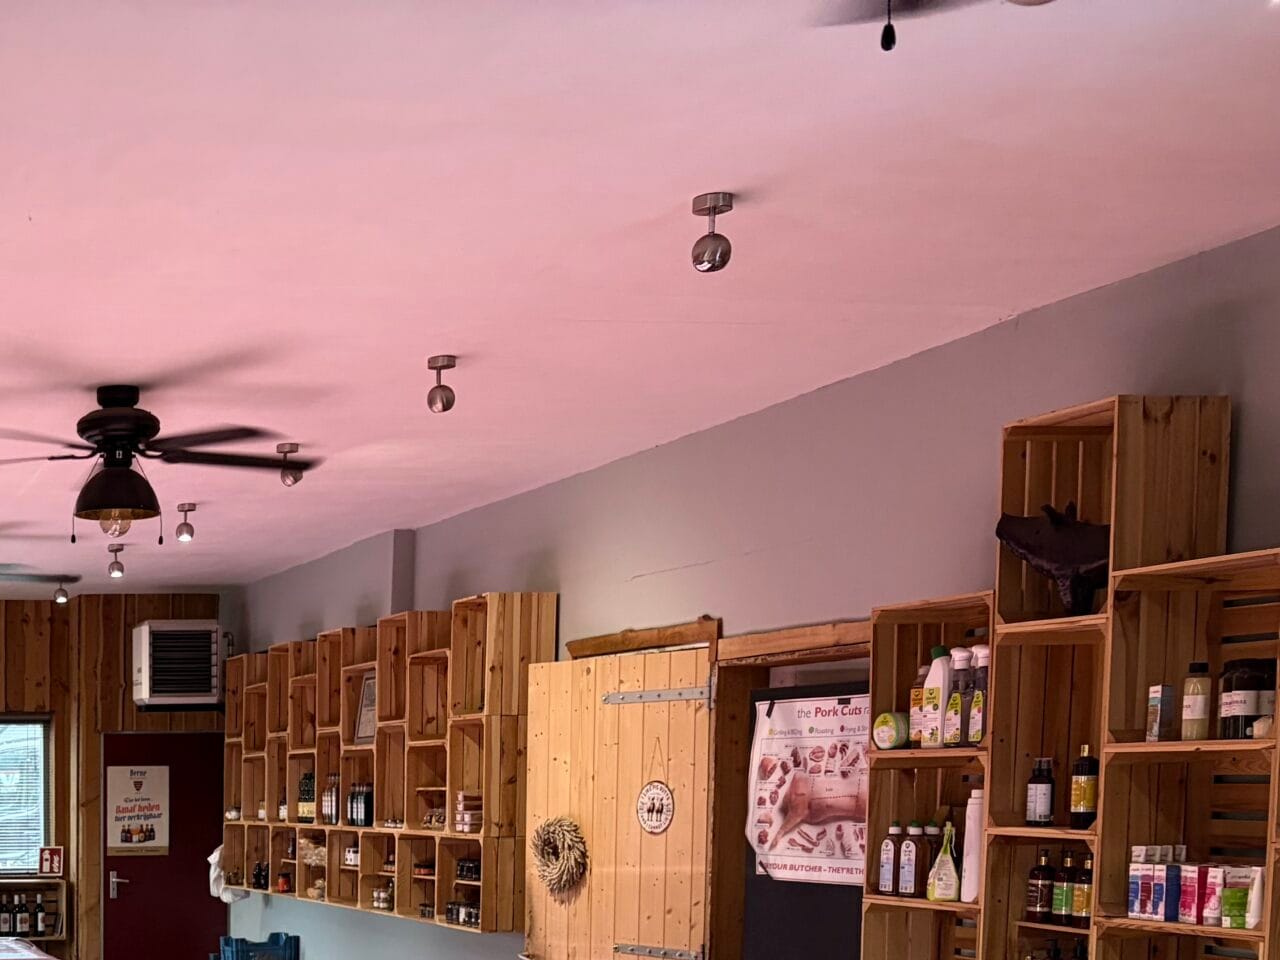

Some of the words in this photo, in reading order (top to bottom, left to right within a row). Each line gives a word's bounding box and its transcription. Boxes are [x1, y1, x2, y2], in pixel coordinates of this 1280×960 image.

[797, 708, 812, 719] the
[814, 706, 839, 718] Pork
[841, 705, 863, 716] Cuts
[789, 864, 823, 873] BUTCHER
